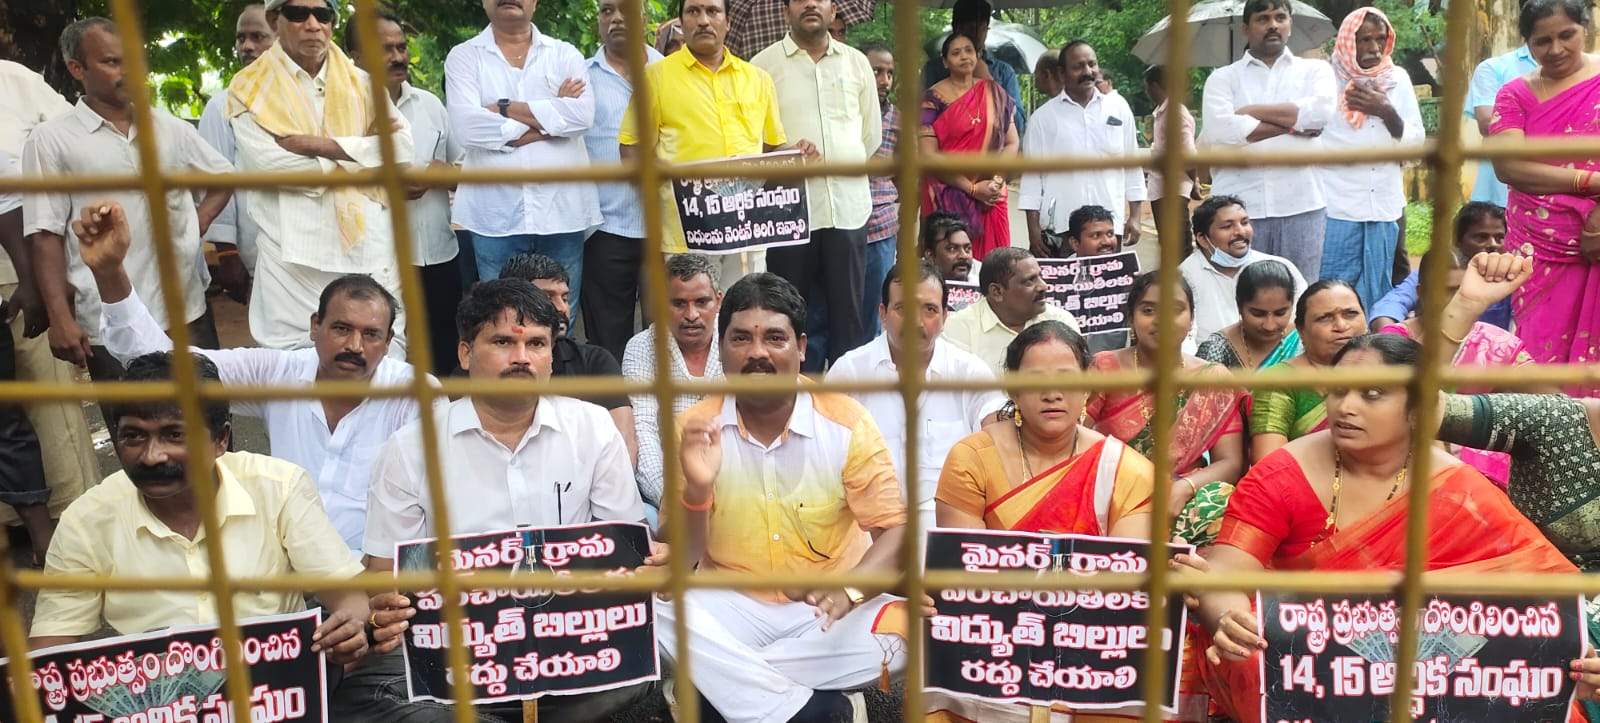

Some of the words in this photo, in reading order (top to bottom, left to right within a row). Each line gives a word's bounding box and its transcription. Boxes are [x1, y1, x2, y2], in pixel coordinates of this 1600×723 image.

[682, 197, 703, 217] 14,
[704, 194, 721, 215] 15
[755, 186, 800, 208] సంఘం
[686, 228, 723, 246] నిధులను
[724, 220, 752, 244] వెంటనే
[753, 219, 775, 238] తిరిగి
[1089, 259, 1124, 276] గ్రామ
[542, 533, 615, 567] గ్రామ
[960, 541, 1053, 573] మైనర్
[1067, 550, 1148, 577] గ్రామ
[532, 602, 648, 644] బిల్లులు
[930, 612, 1047, 658] విద్యుత్
[1278, 598, 1330, 653] రాష్ట్ర
[1424, 599, 1562, 638] దొంగిలించిన
[66, 650, 161, 702] ప్రభుత్వం
[513, 646, 622, 682] చేయాలి
[960, 658, 1023, 696] రద్దు
[1028, 660, 1137, 691] చేయాలి
[1279, 654, 1325, 699] 14,
[1330, 655, 1366, 697] 15
[1454, 654, 1563, 706] సంఘం
